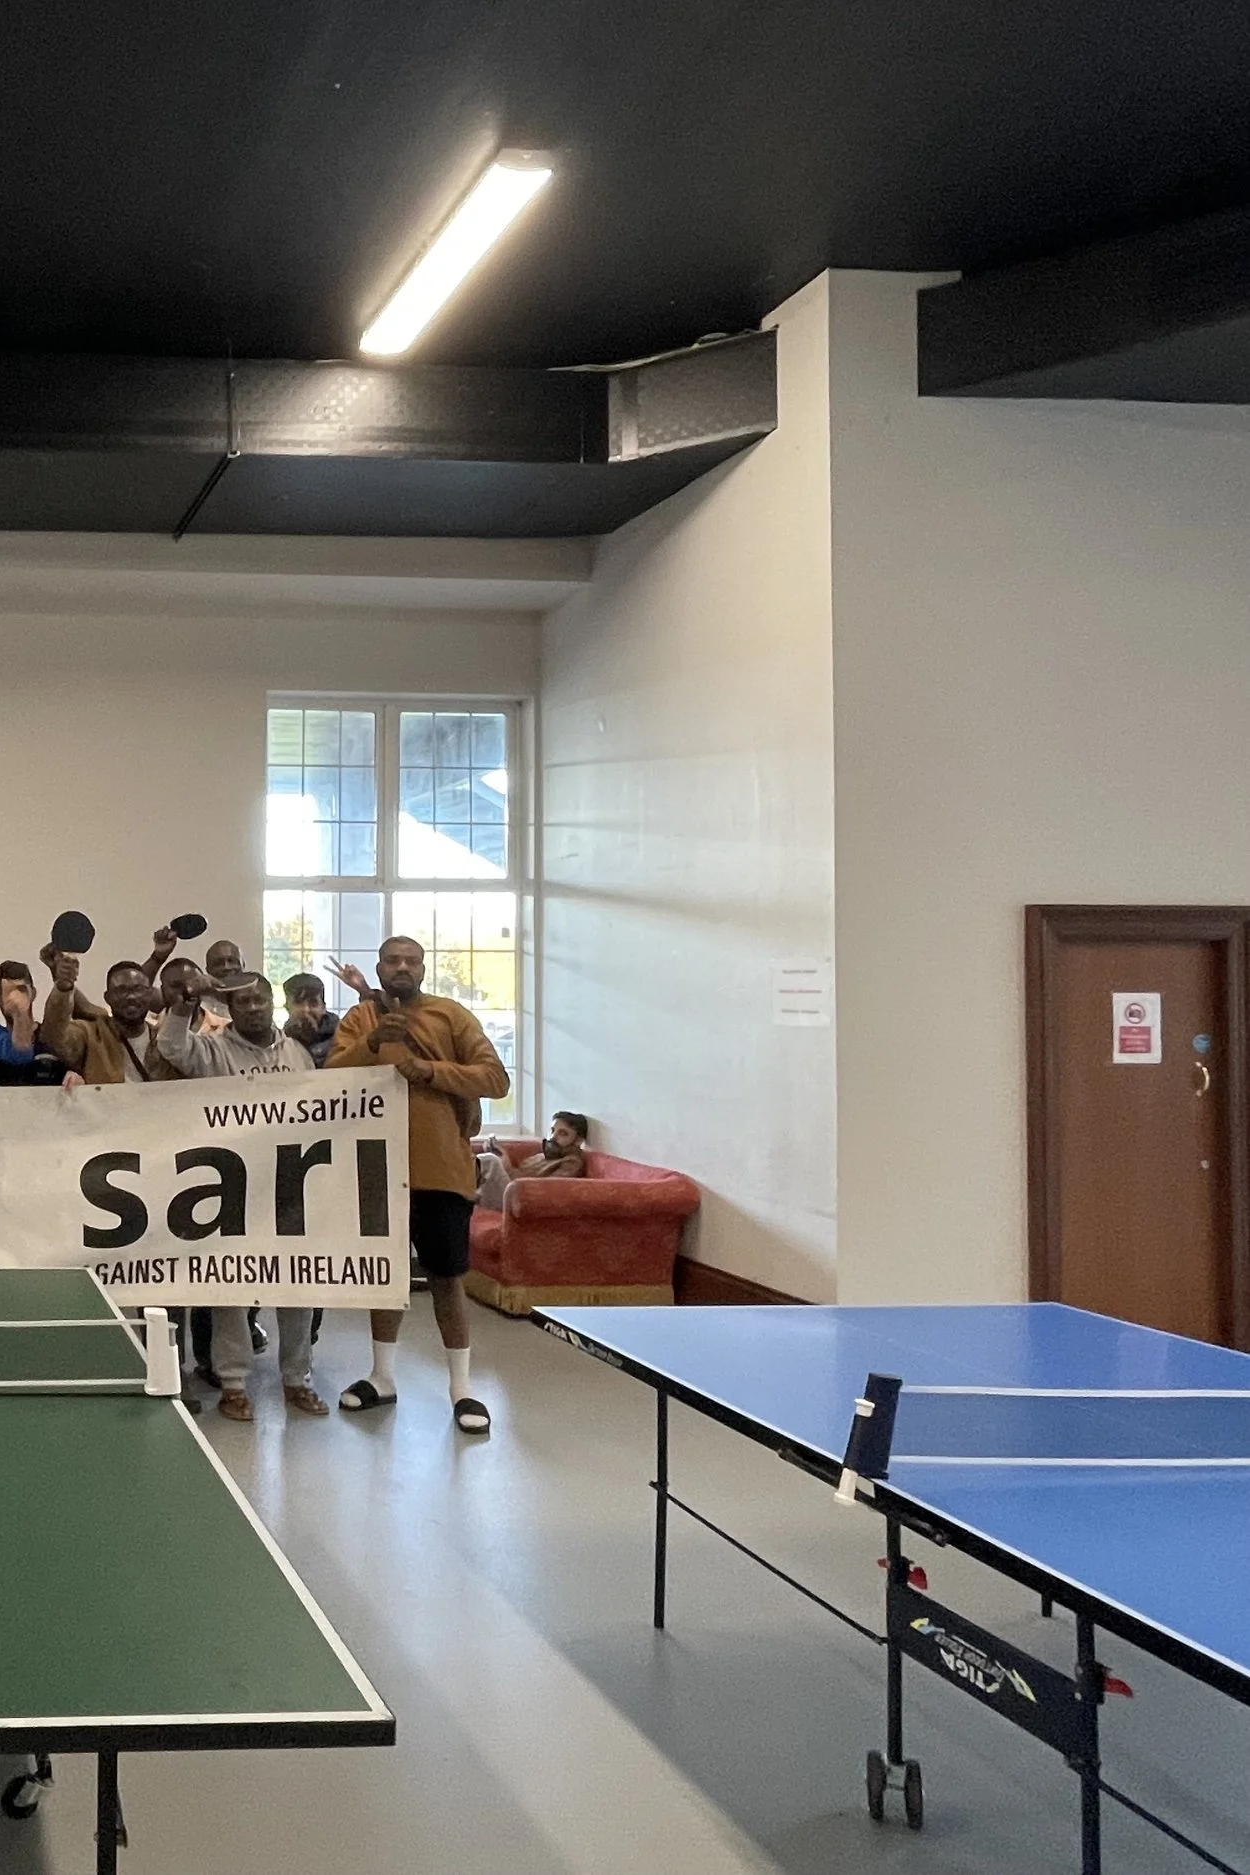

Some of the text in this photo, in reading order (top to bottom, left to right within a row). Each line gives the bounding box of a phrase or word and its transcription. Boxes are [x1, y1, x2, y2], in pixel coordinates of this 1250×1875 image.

[203, 1088, 385, 1128] www.sari.ie
[79, 1139, 390, 1249] sari
[84, 1255, 391, 1285] GAINST RACISM IRELAND
